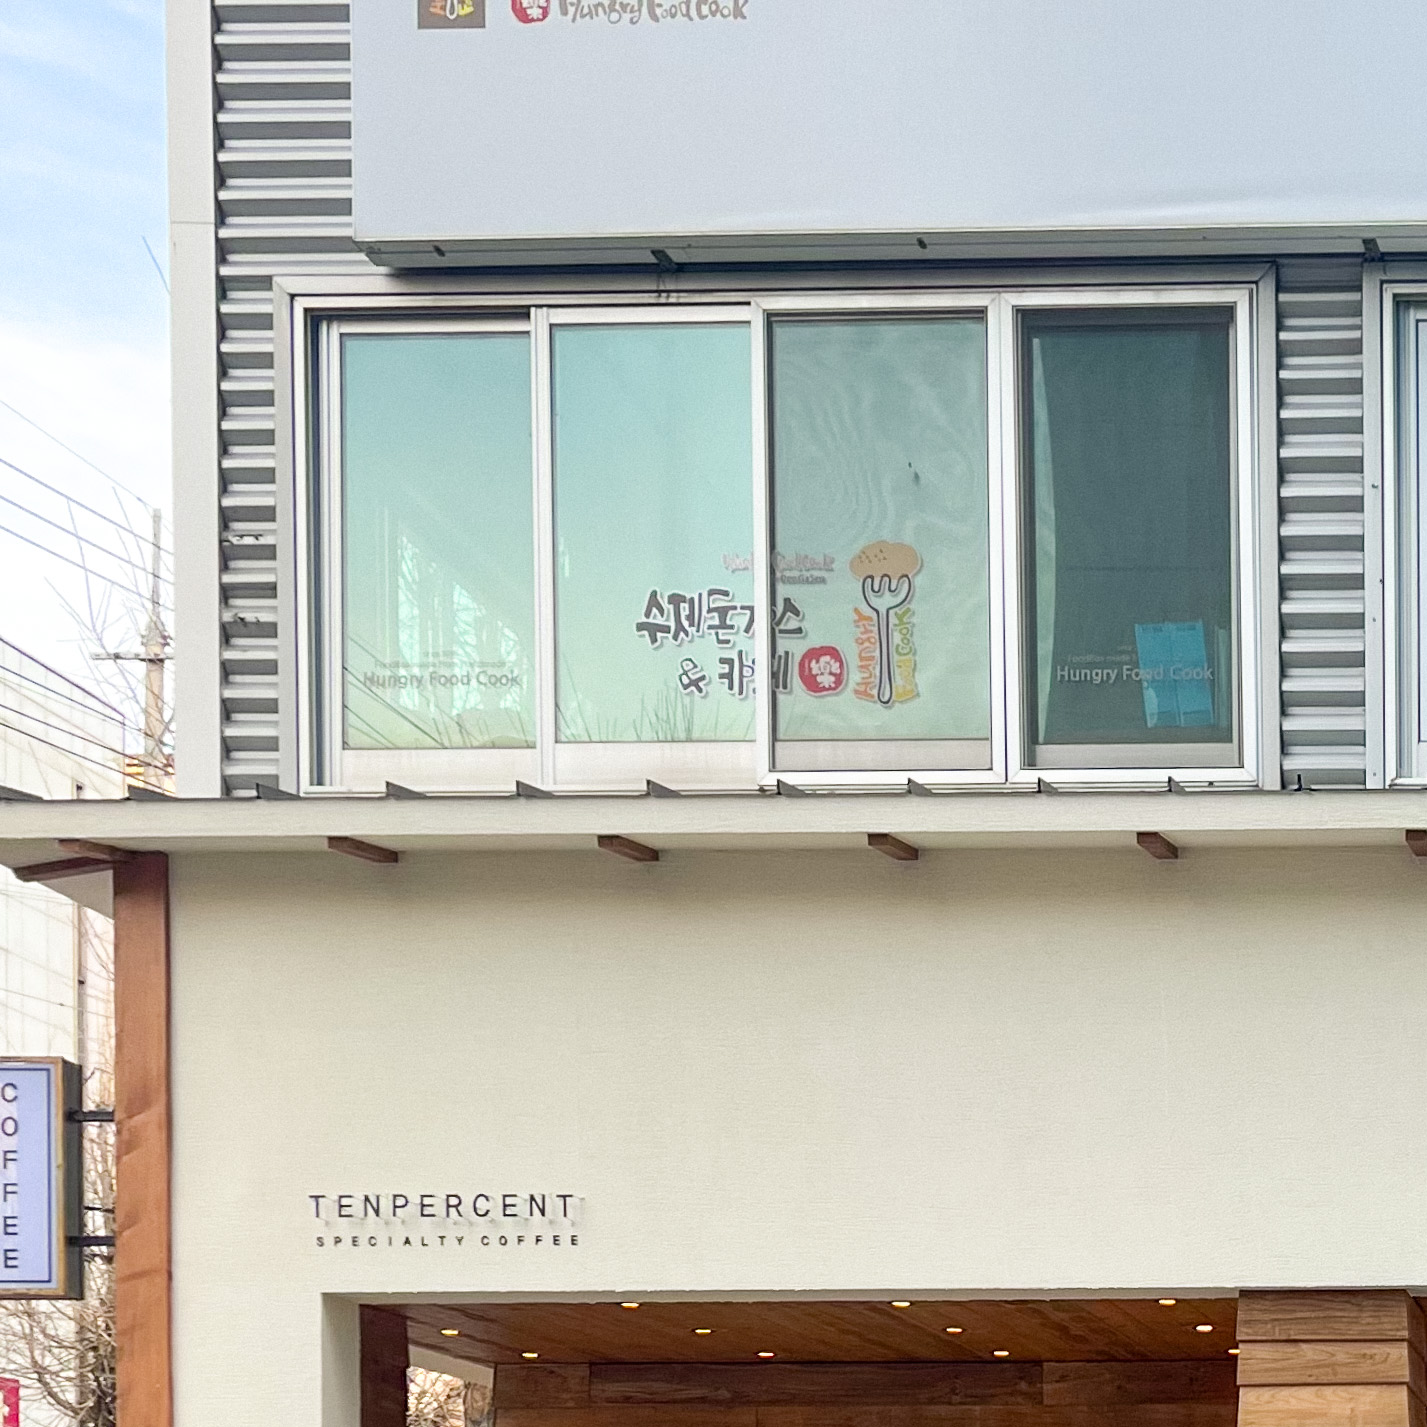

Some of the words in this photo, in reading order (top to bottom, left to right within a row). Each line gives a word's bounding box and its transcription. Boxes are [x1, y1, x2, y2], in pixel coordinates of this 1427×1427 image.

[363, 671, 423, 689] Hungry
[430, 671, 470, 686] Food
[476, 670, 521, 686] Cook
[1057, 665, 1118, 683] Hungry
[1123, 664, 1164, 681] Food
[1170, 664, 1214, 681] Cook
[308, 1193, 574, 1218] TENPERCENT
[316, 1235, 465, 1247] SPECIALTY
[480, 1234, 579, 1246] COFFEE
